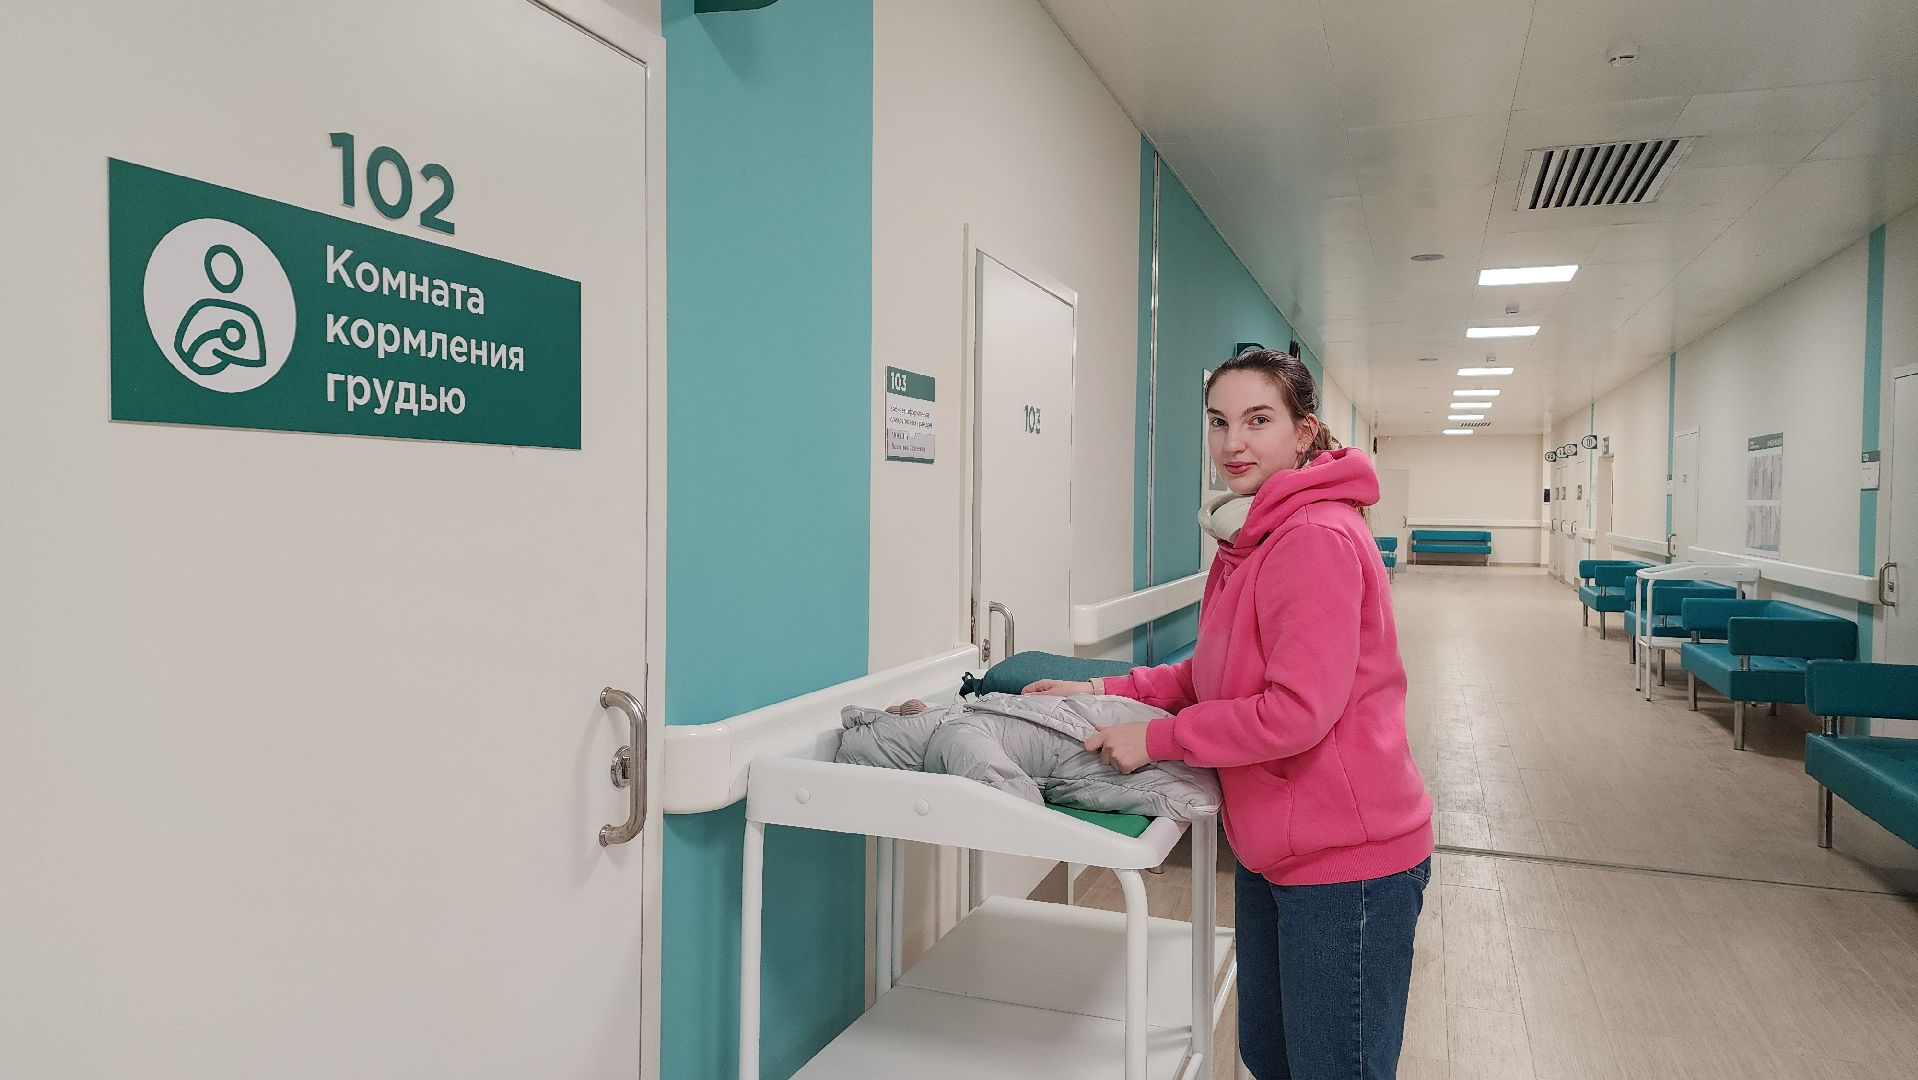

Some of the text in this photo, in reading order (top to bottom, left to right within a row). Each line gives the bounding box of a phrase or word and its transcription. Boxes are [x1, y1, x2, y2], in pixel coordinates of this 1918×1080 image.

[328, 132, 455, 235] 102
[326, 245, 485, 315] Комната
[326, 313, 525, 372] кормления
[326, 372, 466, 416] грудью
[890, 371, 907, 392] 103
[1024, 404, 1041, 435] 103
